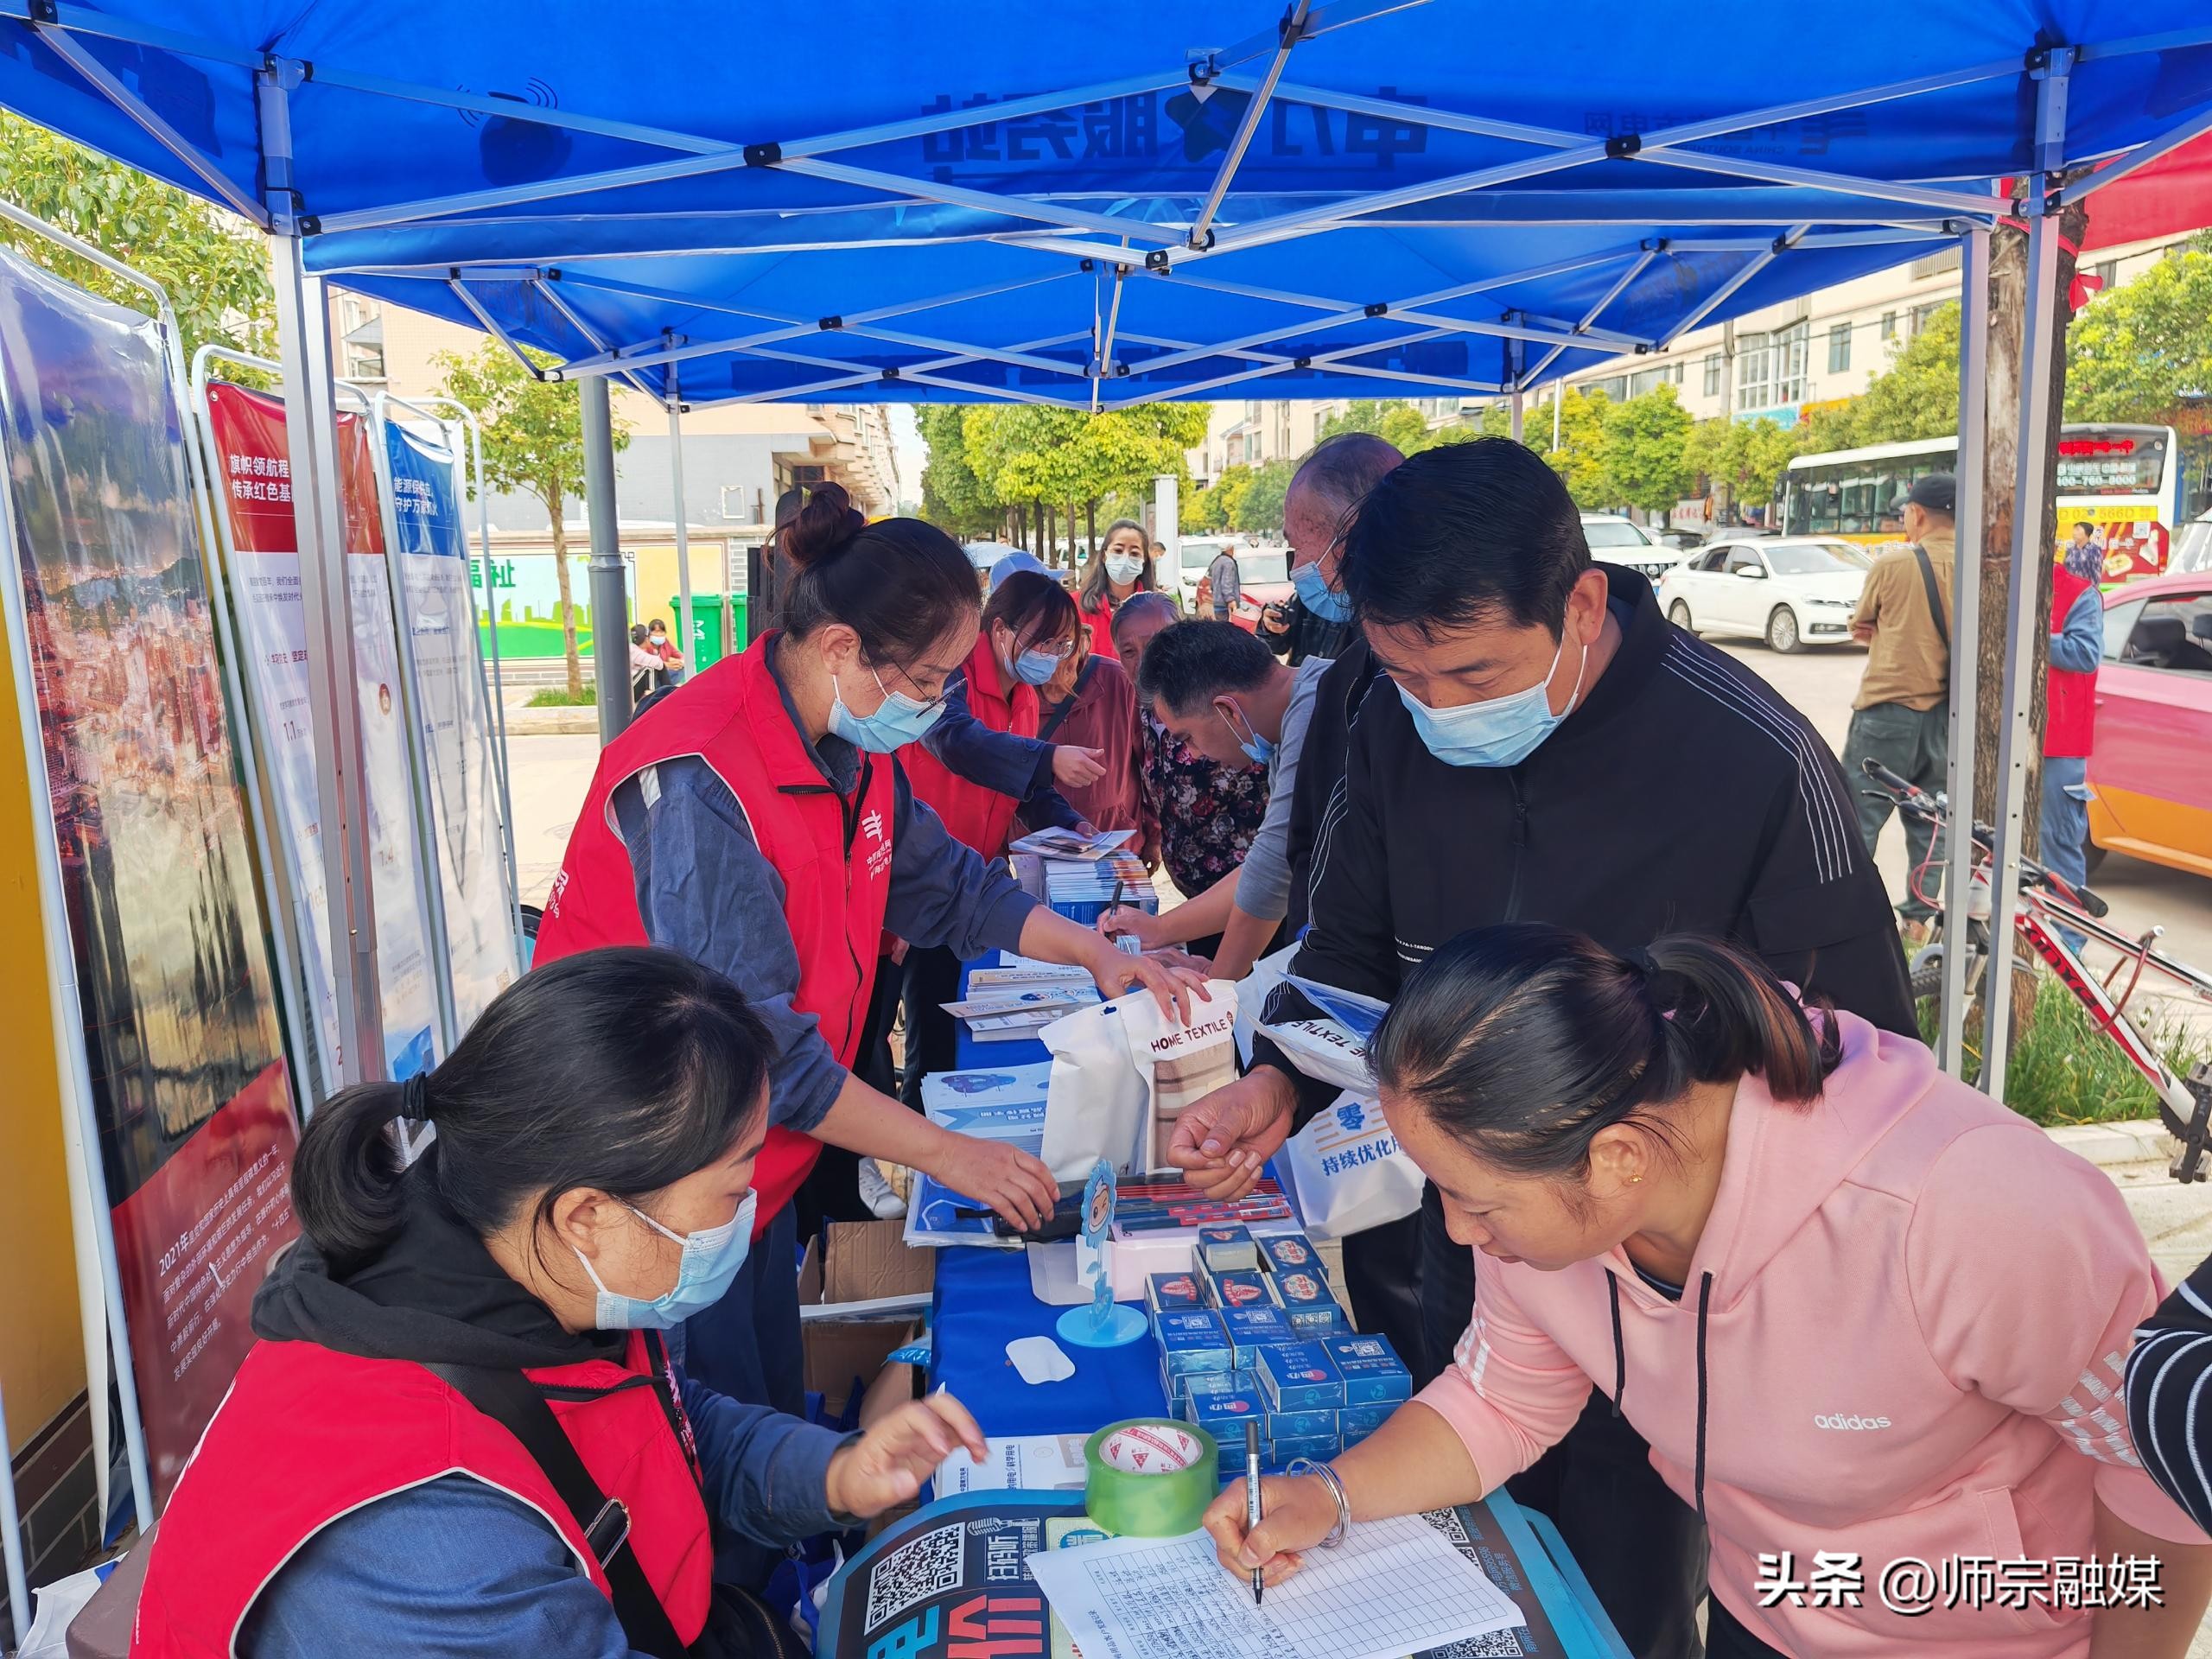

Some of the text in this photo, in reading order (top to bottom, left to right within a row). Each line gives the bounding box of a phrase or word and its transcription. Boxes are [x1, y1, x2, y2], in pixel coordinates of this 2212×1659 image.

[232, 480, 294, 502] 传承红色基
[1150, 1018, 1229, 1053] HOME TEXTILE
[1337, 1099, 1368, 1133] 零
[1814, 1413, 1891, 1432] adidas
[987, 1535, 1020, 1581] 扫码听
